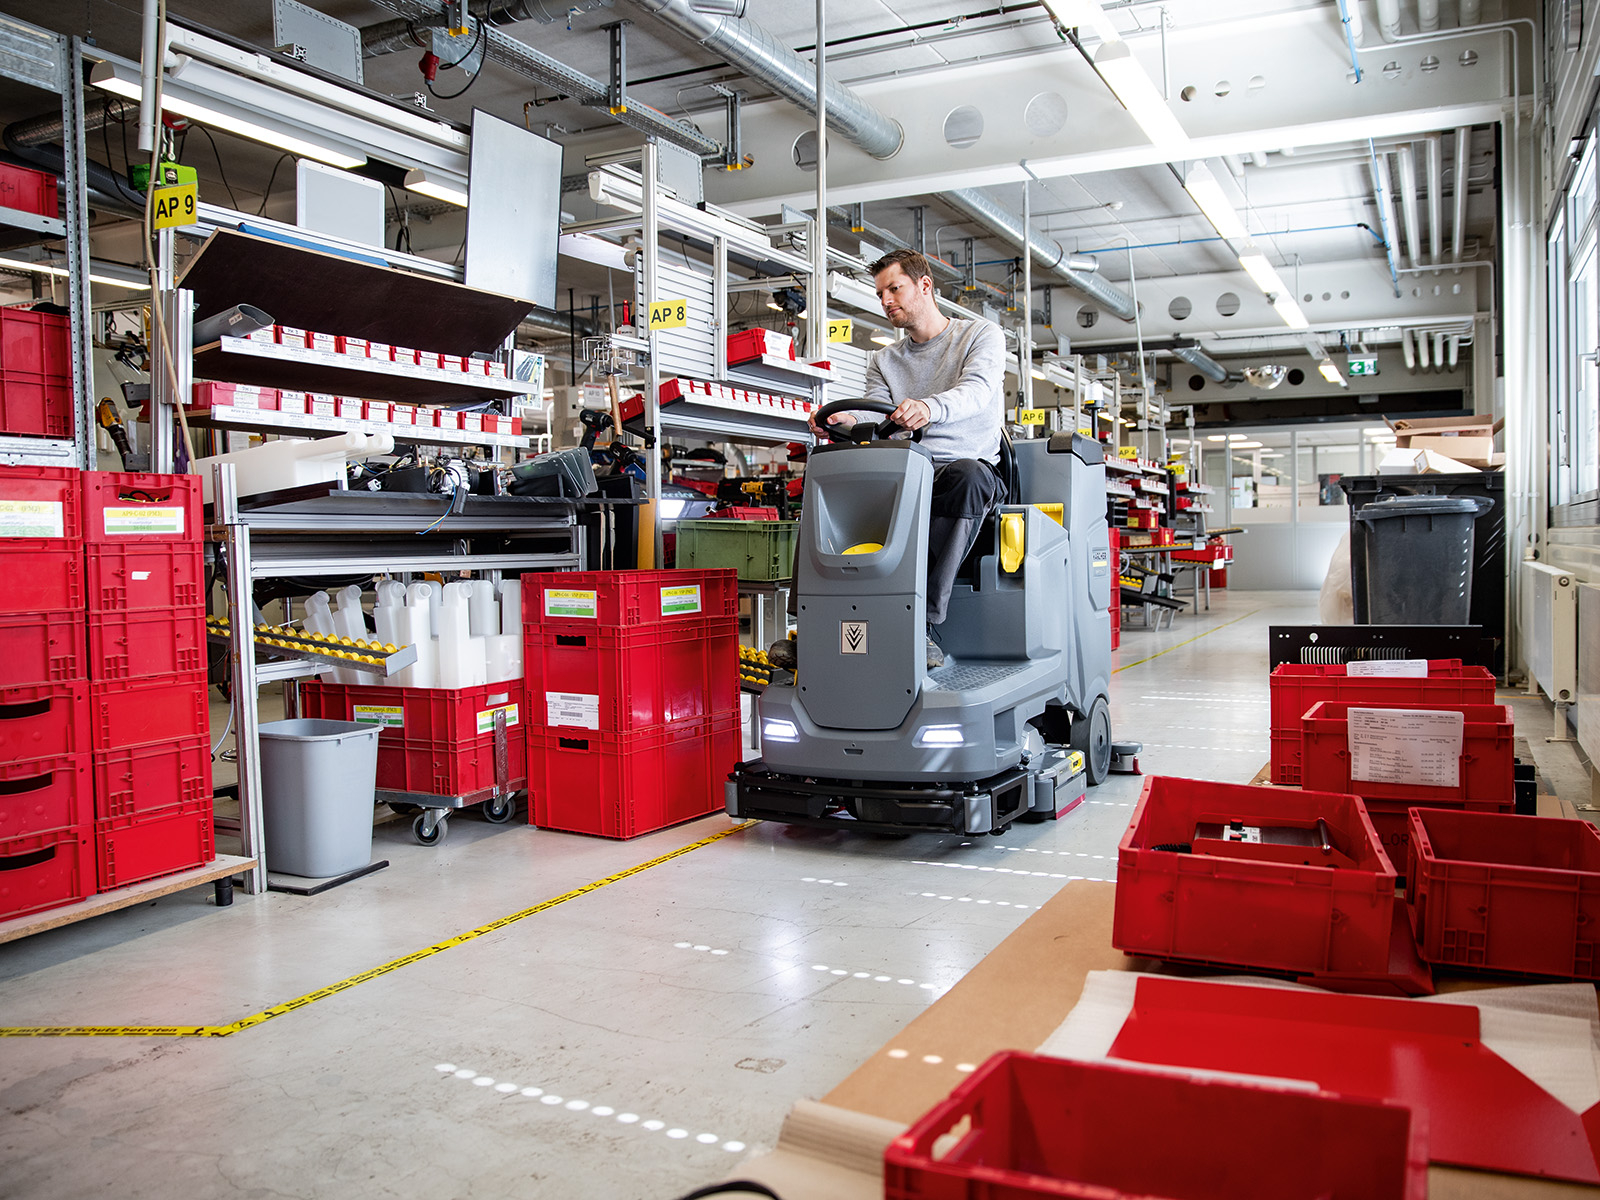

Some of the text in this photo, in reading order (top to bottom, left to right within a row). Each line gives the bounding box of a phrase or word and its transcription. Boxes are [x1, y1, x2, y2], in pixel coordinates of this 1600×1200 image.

[156, 194, 194, 219] AP 9
[651, 306, 685, 323] AP 8
[842, 325, 849, 337] 7
[1022, 413, 1043, 421] AP 6
